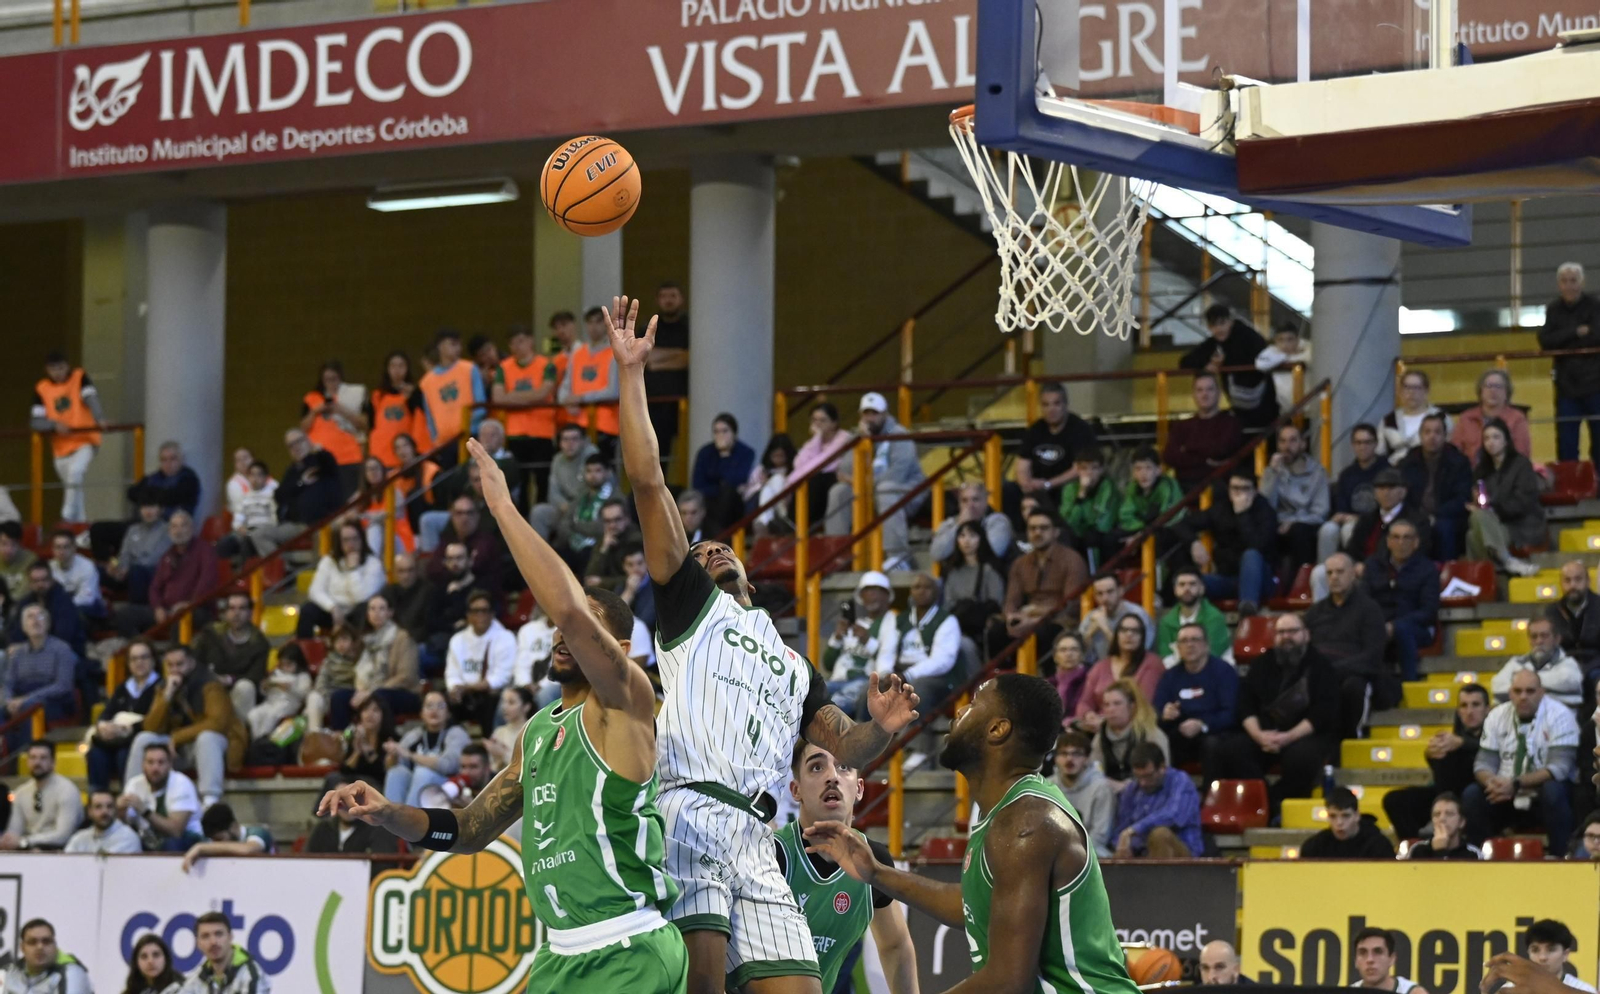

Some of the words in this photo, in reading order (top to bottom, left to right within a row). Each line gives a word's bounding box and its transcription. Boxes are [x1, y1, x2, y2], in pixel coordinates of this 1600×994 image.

[646, 28, 861, 116] VISTA
[887, 0, 1210, 95] ALGRE
[1414, 20, 1530, 51] Intituto
[1536, 10, 1600, 39] Mun
[159, 21, 473, 121] IMDECO
[69, 143, 149, 168] Instituto
[152, 130, 248, 161] Municipal
[251, 129, 278, 151] de
[282, 125, 375, 153] Deportes
[379, 113, 468, 141] Córdoba
[723, 628, 786, 676] coto
[382, 887, 537, 956] CORDOB
